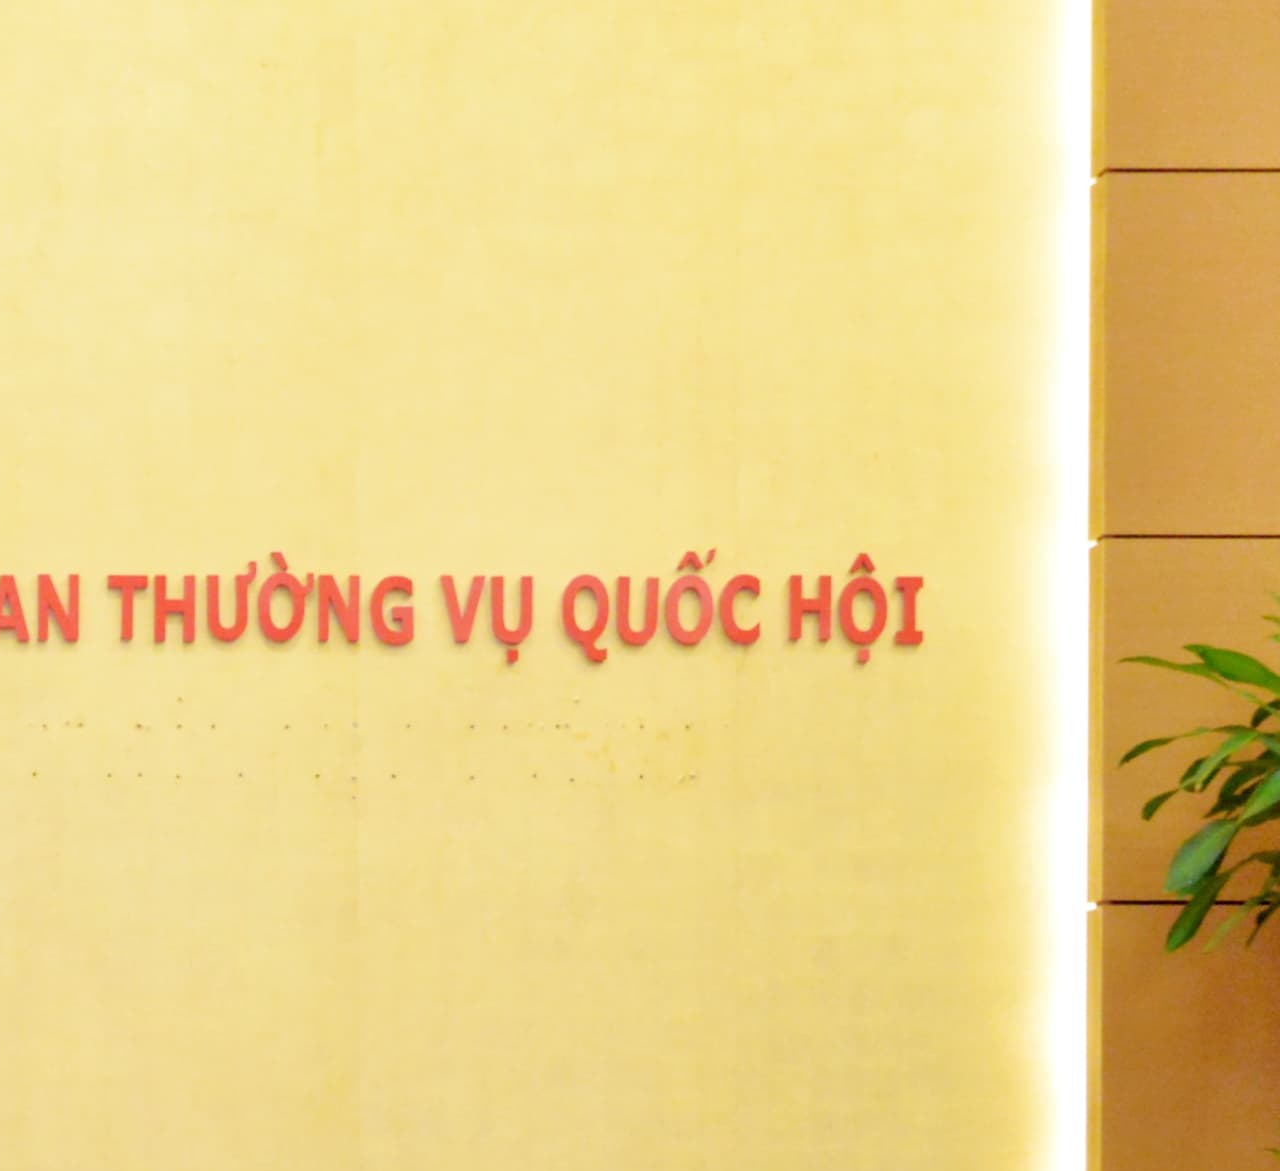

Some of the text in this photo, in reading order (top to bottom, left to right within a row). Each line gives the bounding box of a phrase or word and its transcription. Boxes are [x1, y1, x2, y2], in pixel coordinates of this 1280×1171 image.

[107, 551, 415, 646] THƯỜNG
[441, 575, 534, 664] VỤ
[561, 549, 761, 663] QUỐC
[789, 553, 924, 664] HỘI
